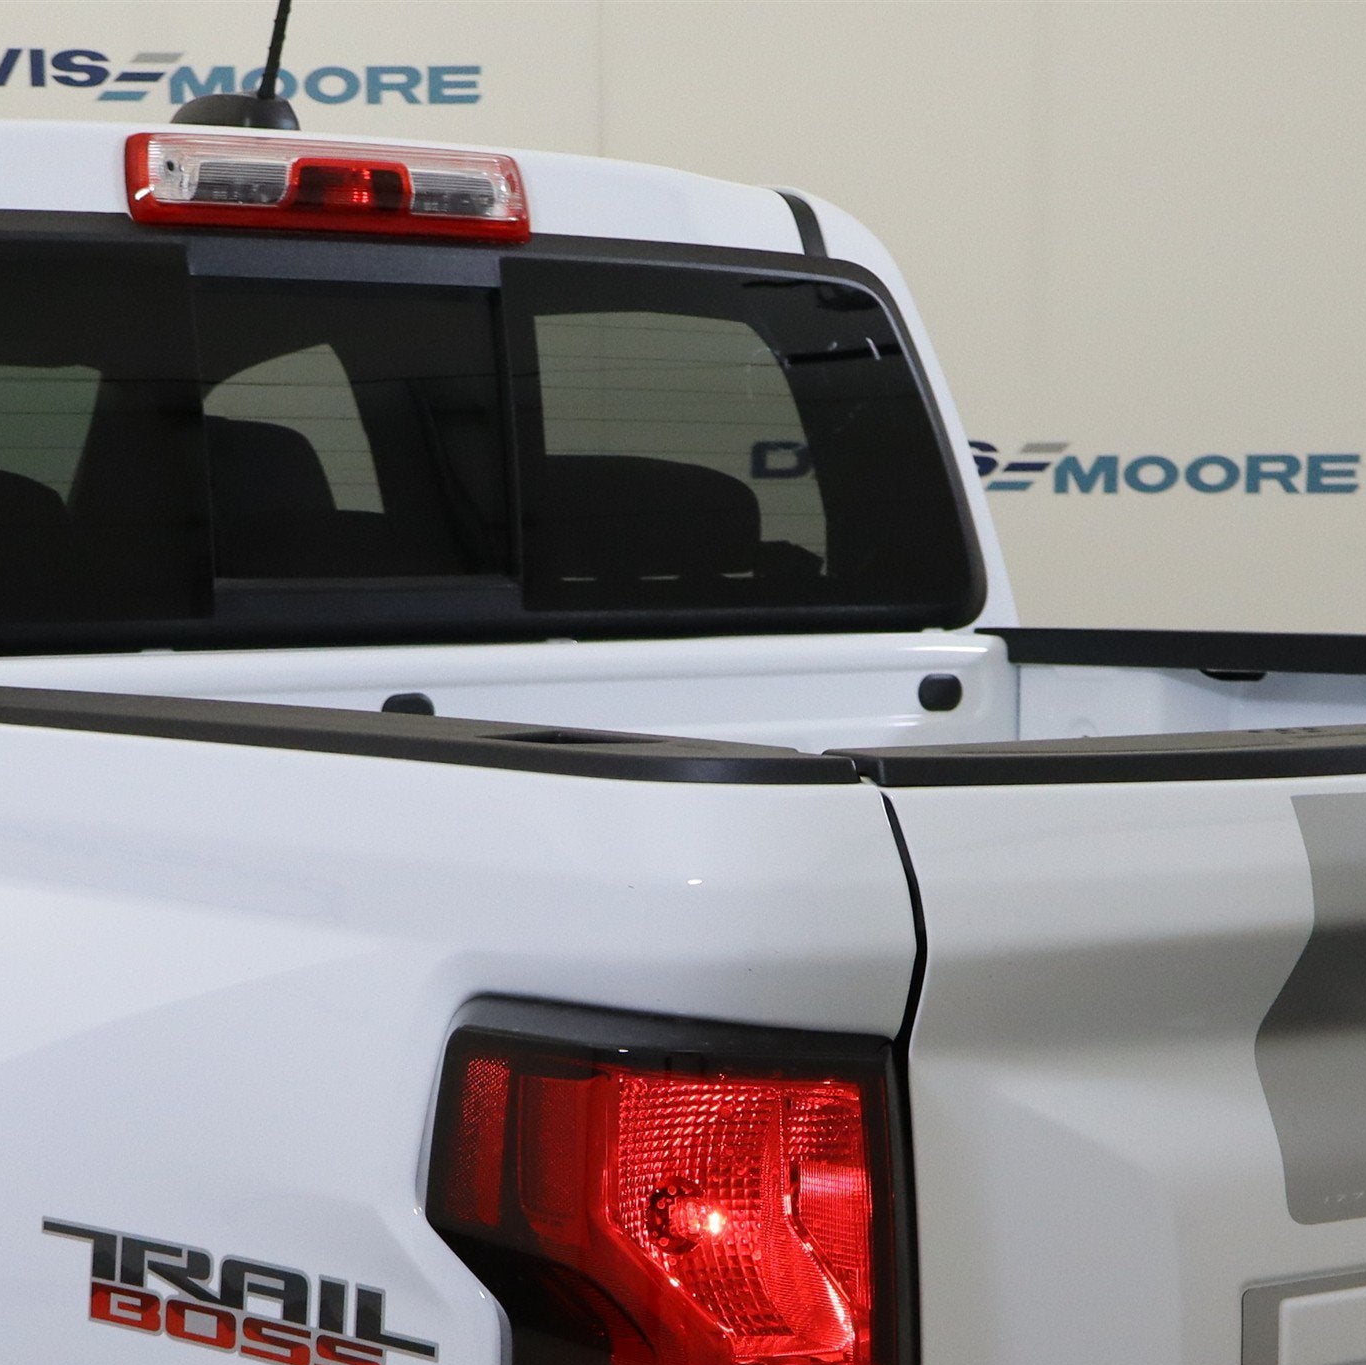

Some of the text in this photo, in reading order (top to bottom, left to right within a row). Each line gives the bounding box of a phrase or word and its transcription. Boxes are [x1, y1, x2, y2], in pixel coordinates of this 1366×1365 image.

[171, 65, 482, 106] MOORE
[1053, 454, 1361, 494] MOORE
[41, 1215, 440, 1363] TRAIL
